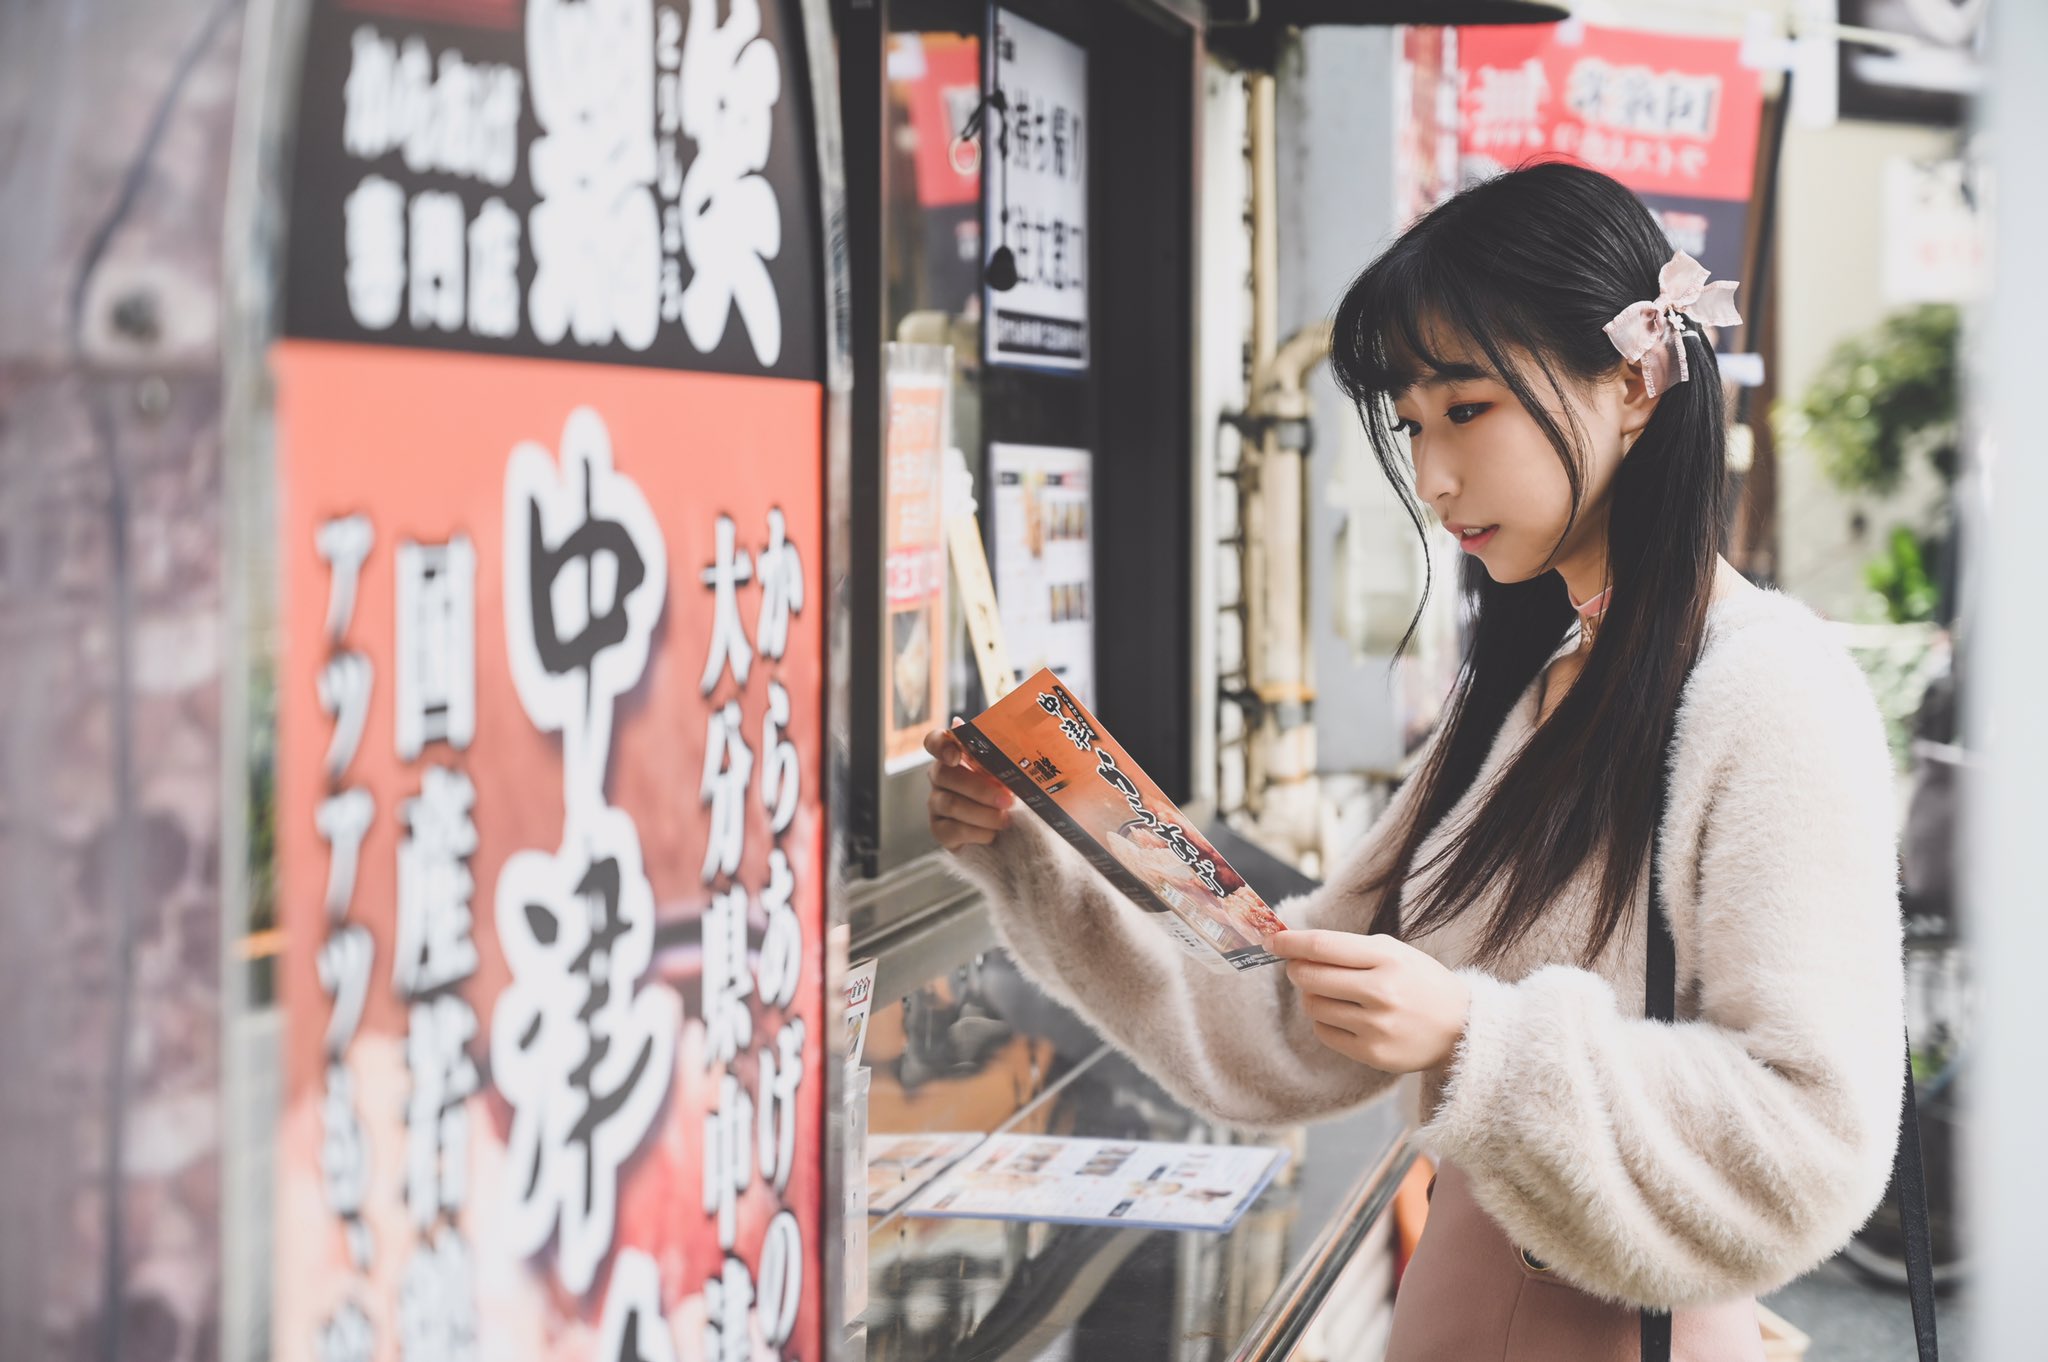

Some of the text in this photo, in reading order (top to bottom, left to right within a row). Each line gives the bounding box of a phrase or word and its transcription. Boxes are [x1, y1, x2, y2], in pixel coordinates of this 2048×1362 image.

[757, 505, 804, 1347] からあげの
[1036, 692, 1225, 897] 中津からあげ
